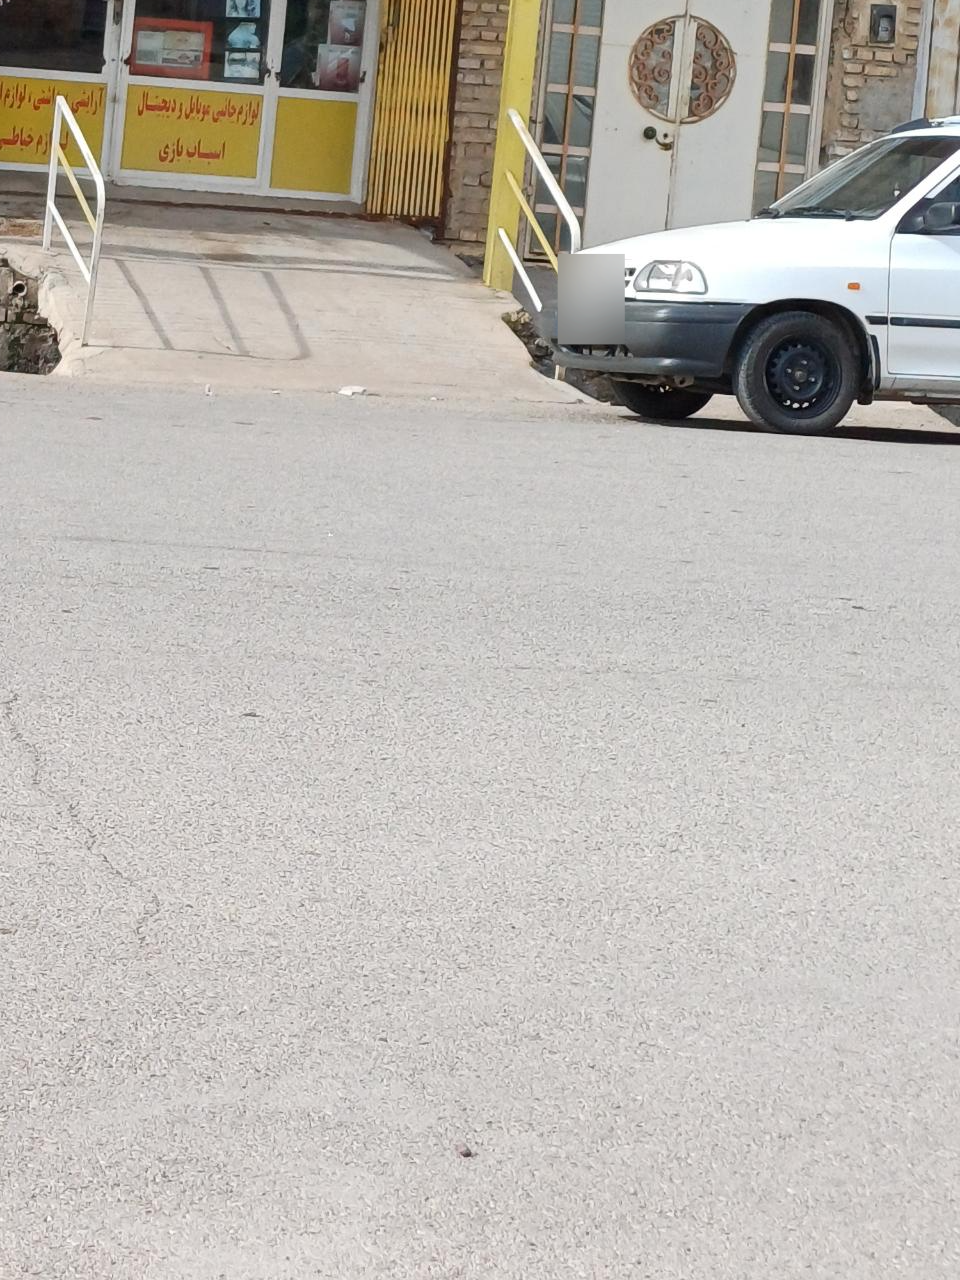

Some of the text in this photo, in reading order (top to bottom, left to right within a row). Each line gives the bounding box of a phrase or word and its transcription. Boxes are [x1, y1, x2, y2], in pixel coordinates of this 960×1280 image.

[4, 82, 27, 109] لوازم
[71, 86, 105, 115] آرایشی
[137, 89, 260, 126] لوازم جانبی موبایل و دیجیتال
[158, 136, 226, 165] اسباب بازی
